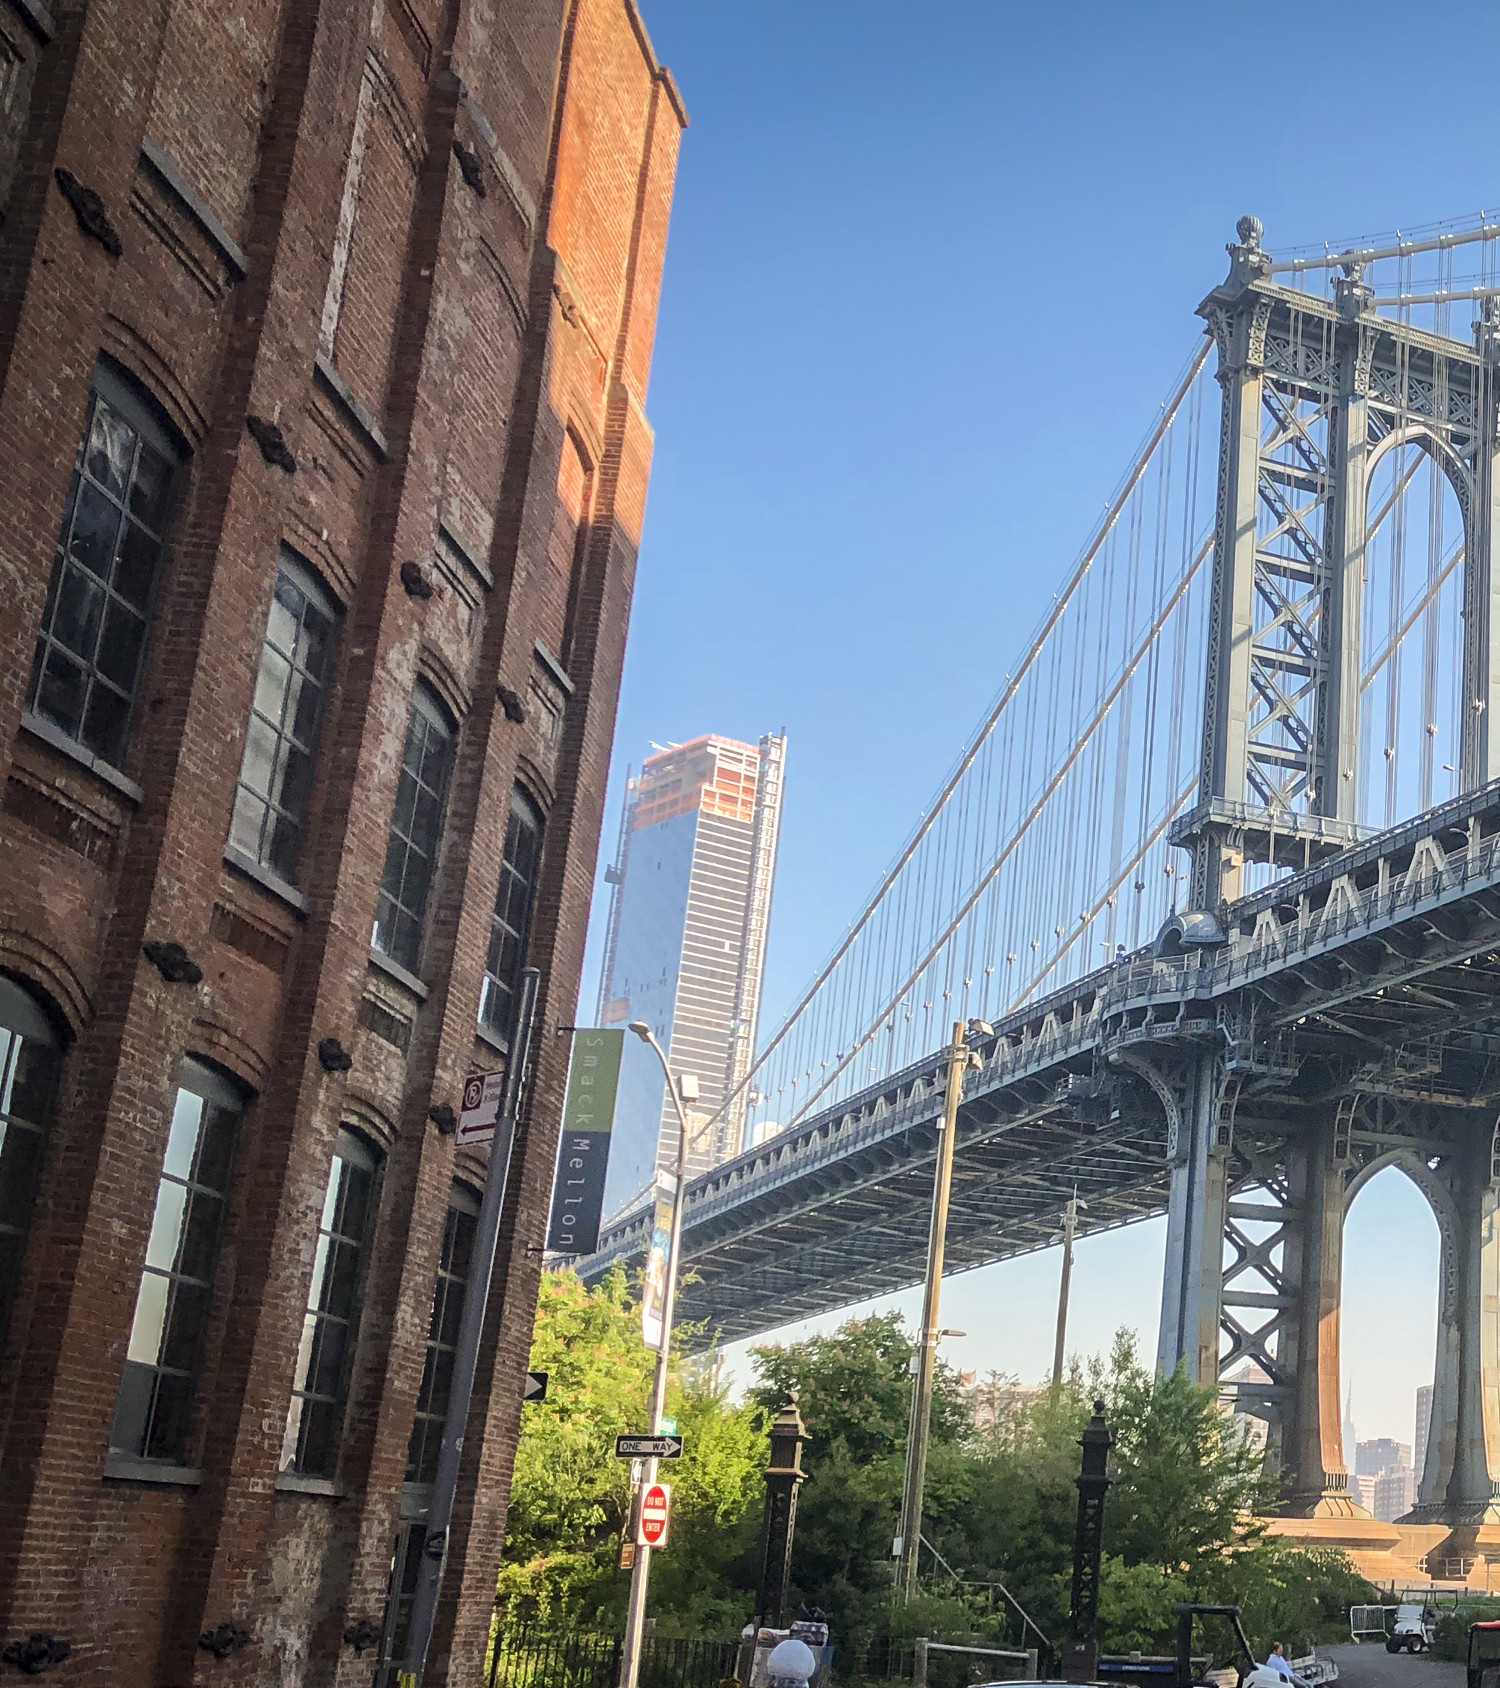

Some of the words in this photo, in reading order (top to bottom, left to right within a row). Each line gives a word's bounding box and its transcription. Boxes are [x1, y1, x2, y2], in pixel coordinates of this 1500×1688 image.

[575, 1038, 603, 1125] Smack
[559, 1138, 590, 1244] Mellon
[622, 1442, 641, 1451] ONE
[652, 1443, 673, 1451] WAY
[647, 1496, 655, 1506] DO
[655, 1497, 665, 1506] NOT
[645, 1523, 661, 1532] ENTER
